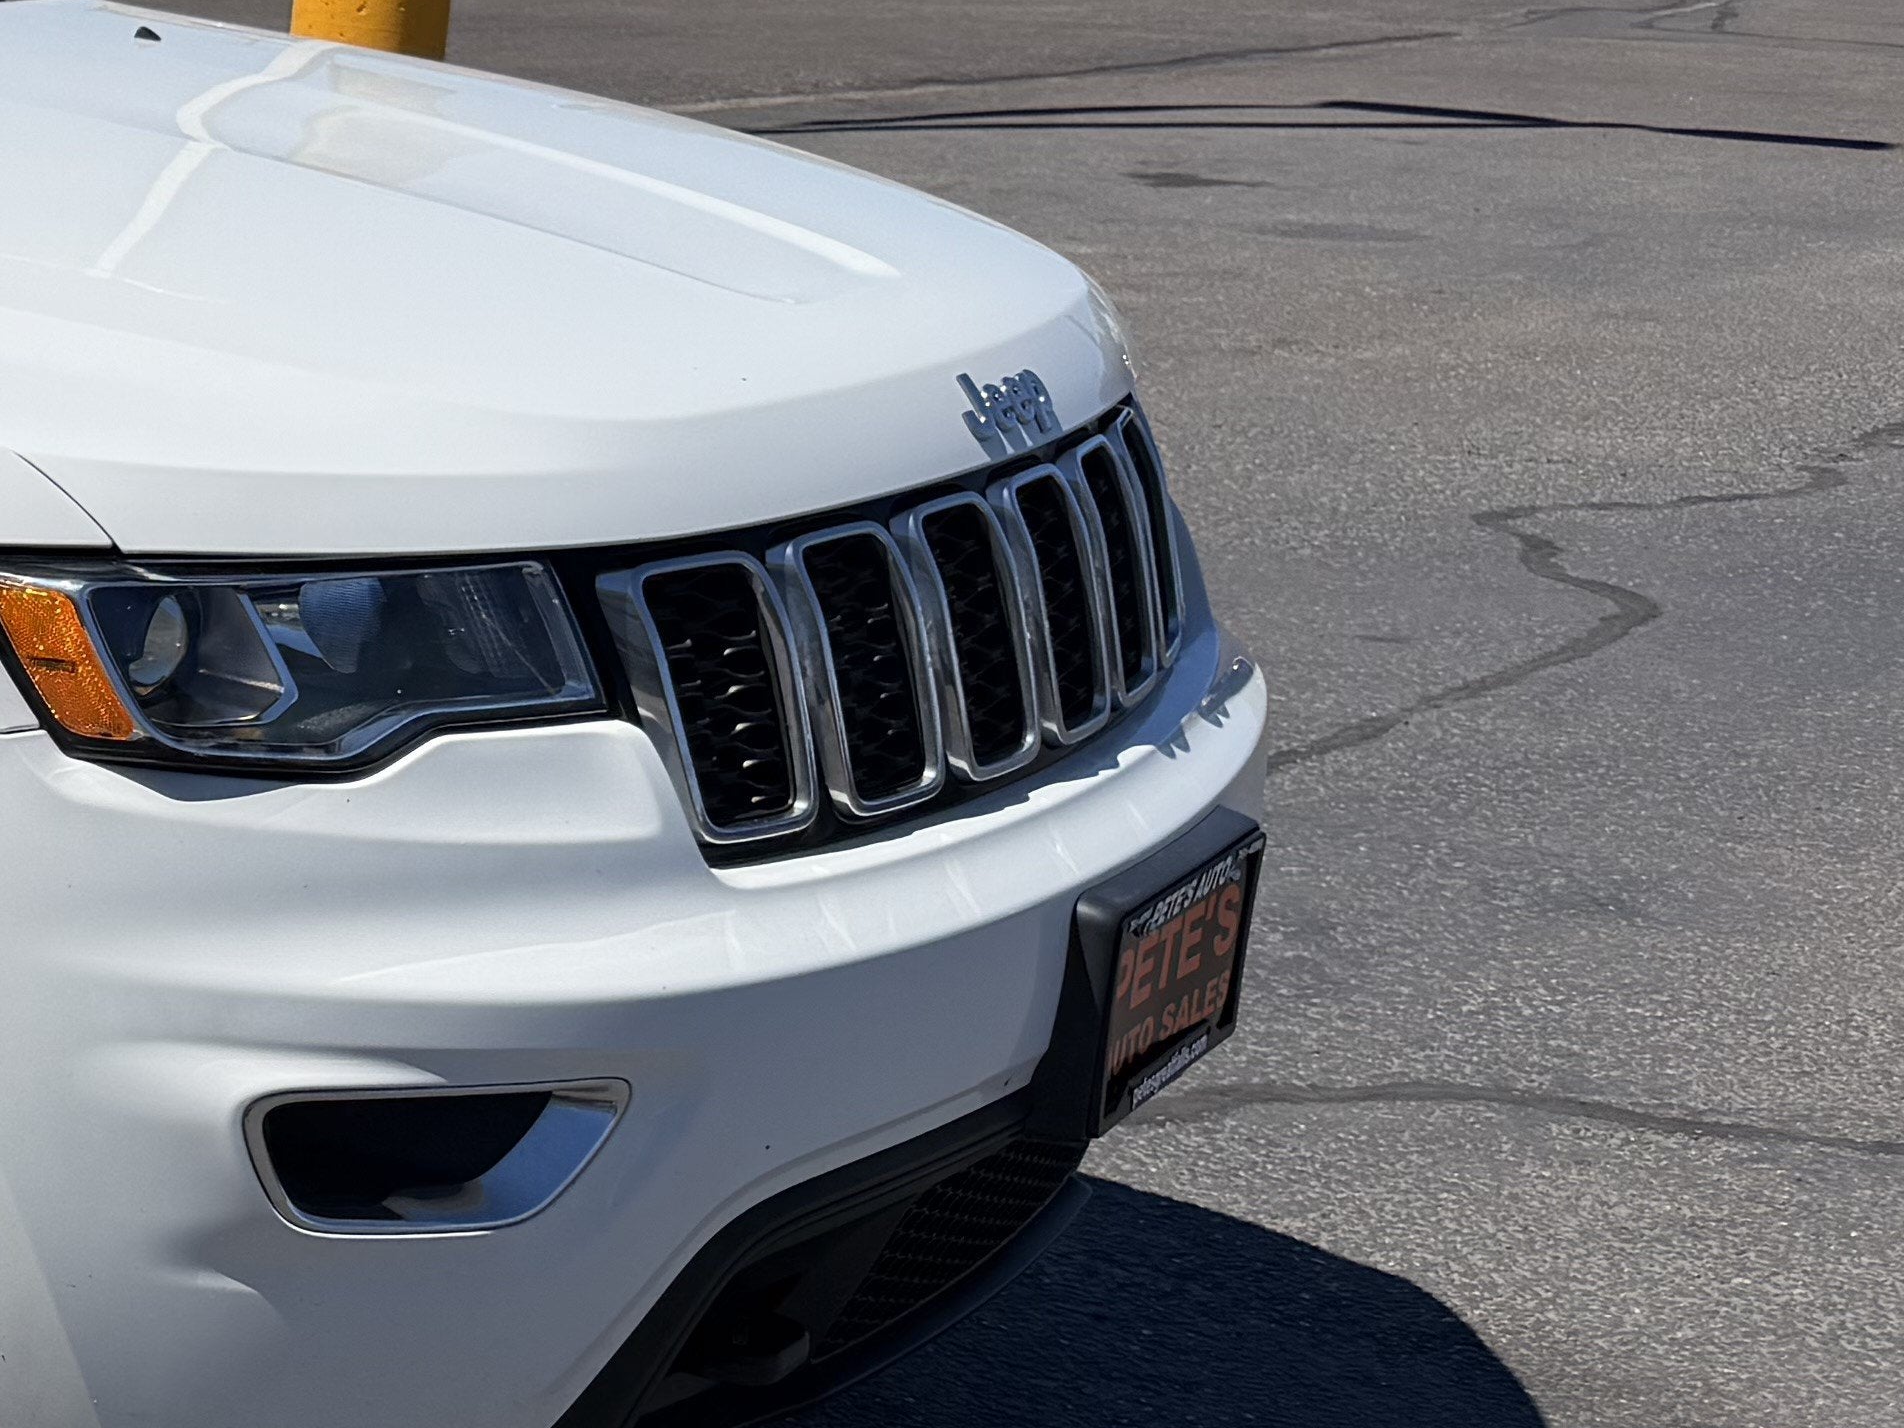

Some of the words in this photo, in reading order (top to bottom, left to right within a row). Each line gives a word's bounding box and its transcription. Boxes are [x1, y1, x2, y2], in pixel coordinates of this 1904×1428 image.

[956, 369, 1053, 442] Jeep
[1116, 884, 1241, 1010] PETE'S
[1106, 1017, 1155, 1076] UTO
[1159, 972, 1231, 1040] SALES
